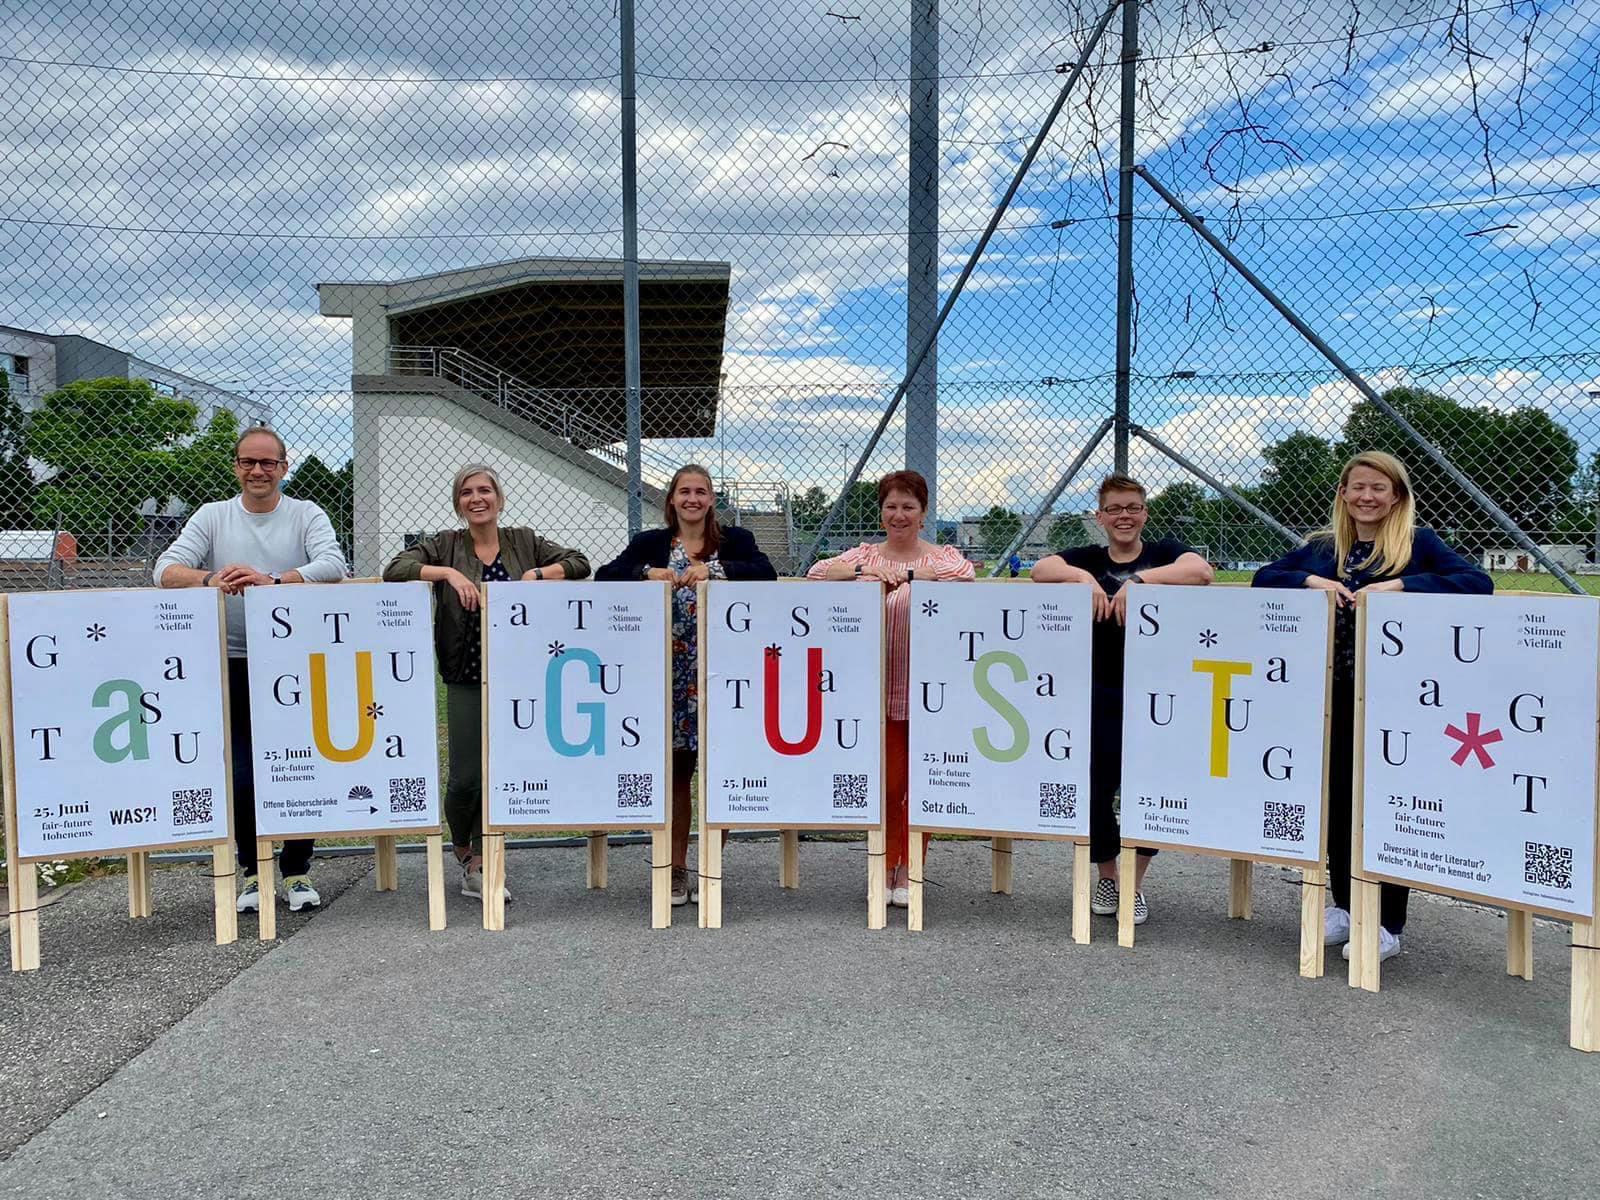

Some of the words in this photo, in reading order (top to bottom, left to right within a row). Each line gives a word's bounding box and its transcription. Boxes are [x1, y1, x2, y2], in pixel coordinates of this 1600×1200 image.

[272, 607, 292, 639] S
[324, 613, 350, 644] T
[510, 602, 529, 627] a
[568, 600, 592, 630] T
[726, 602, 752, 633] G
[791, 606, 810, 637] S
[1001, 609, 1027, 640] U
[1139, 604, 1160, 637] S
[26, 634, 59, 668] G
[959, 631, 984, 662] T
[1381, 620, 1404, 657] S
[1451, 626, 1484, 663] U
[164, 656, 186, 680] a
[389, 651, 416, 682] U
[597, 665, 624, 694] U
[817, 669, 836, 692] a
[1267, 657, 1289, 683] a
[273, 675, 302, 706] G
[726, 680, 750, 709] T
[920, 682, 947, 713] U
[1036, 672, 1056, 697] a
[1419, 679, 1443, 707] a
[139, 692, 161, 724] S
[309, 651, 374, 763] U
[511, 699, 537, 729] U
[545, 648, 605, 757] G
[764, 648, 822, 756] U
[972, 650, 1030, 763] S
[1148, 693, 1176, 726] U
[1222, 698, 1253, 732] U
[1509, 694, 1545, 733] G
[92, 679, 150, 764] a
[621, 716, 640, 747] S
[1192, 660, 1252, 778] T
[31, 727, 61, 761] T
[170, 732, 200, 764] U
[386, 735, 406, 758] a
[835, 719, 860, 749] U
[1044, 728, 1071, 761] G
[1380, 729, 1412, 766] U
[264, 751, 281, 761] 25.
[285, 746, 312, 760] Juni
[923, 753, 939, 763] 25.
[942, 752, 969, 764] Juni
[1262, 746, 1293, 781] G
[271, 764, 315, 773] fair-future
[272, 774, 315, 782] Hohenems
[929, 768, 970, 778] fair-future
[929, 778, 970, 788] Hohenems
[503, 783, 519, 792] 25.
[522, 779, 548, 793] Juni
[723, 779, 738, 789] 25.
[741, 777, 767, 790] Juni
[729, 794, 769, 802] fair-future
[1513, 773, 1547, 814] T
[34, 807, 54, 818] 25.
[58, 801, 89, 816] Juni
[263, 801, 285, 809] Offene
[286, 799, 338, 809] Bücherschränke
[288, 807, 322, 817] Vorarlberg
[509, 797, 550, 805] fair-future
[922, 800, 943, 813] Setz
[1138, 797, 1156, 807] 25.
[1159, 796, 1188, 810] Juni
[1388, 794, 1408, 808] 25.
[1411, 796, 1443, 812] Juni
[42, 820, 92, 830] fair-future
[110, 807, 157, 825] WAS?!
[1144, 814, 1190, 825] fair-future
[1145, 824, 1189, 835] Hohenems
[1395, 812, 1446, 828] fair-future
[43, 830, 92, 841] Hohenems
[1395, 824, 1446, 840] Hohenems
[1384, 843, 1419, 858] Diversität
[1420, 847, 1428, 859] in
[1431, 849, 1443, 862] der
[1444, 853, 1484, 869] Literatur?
[1447, 865, 1475, 879] kennst
[1476, 872, 1492, 882] du?
